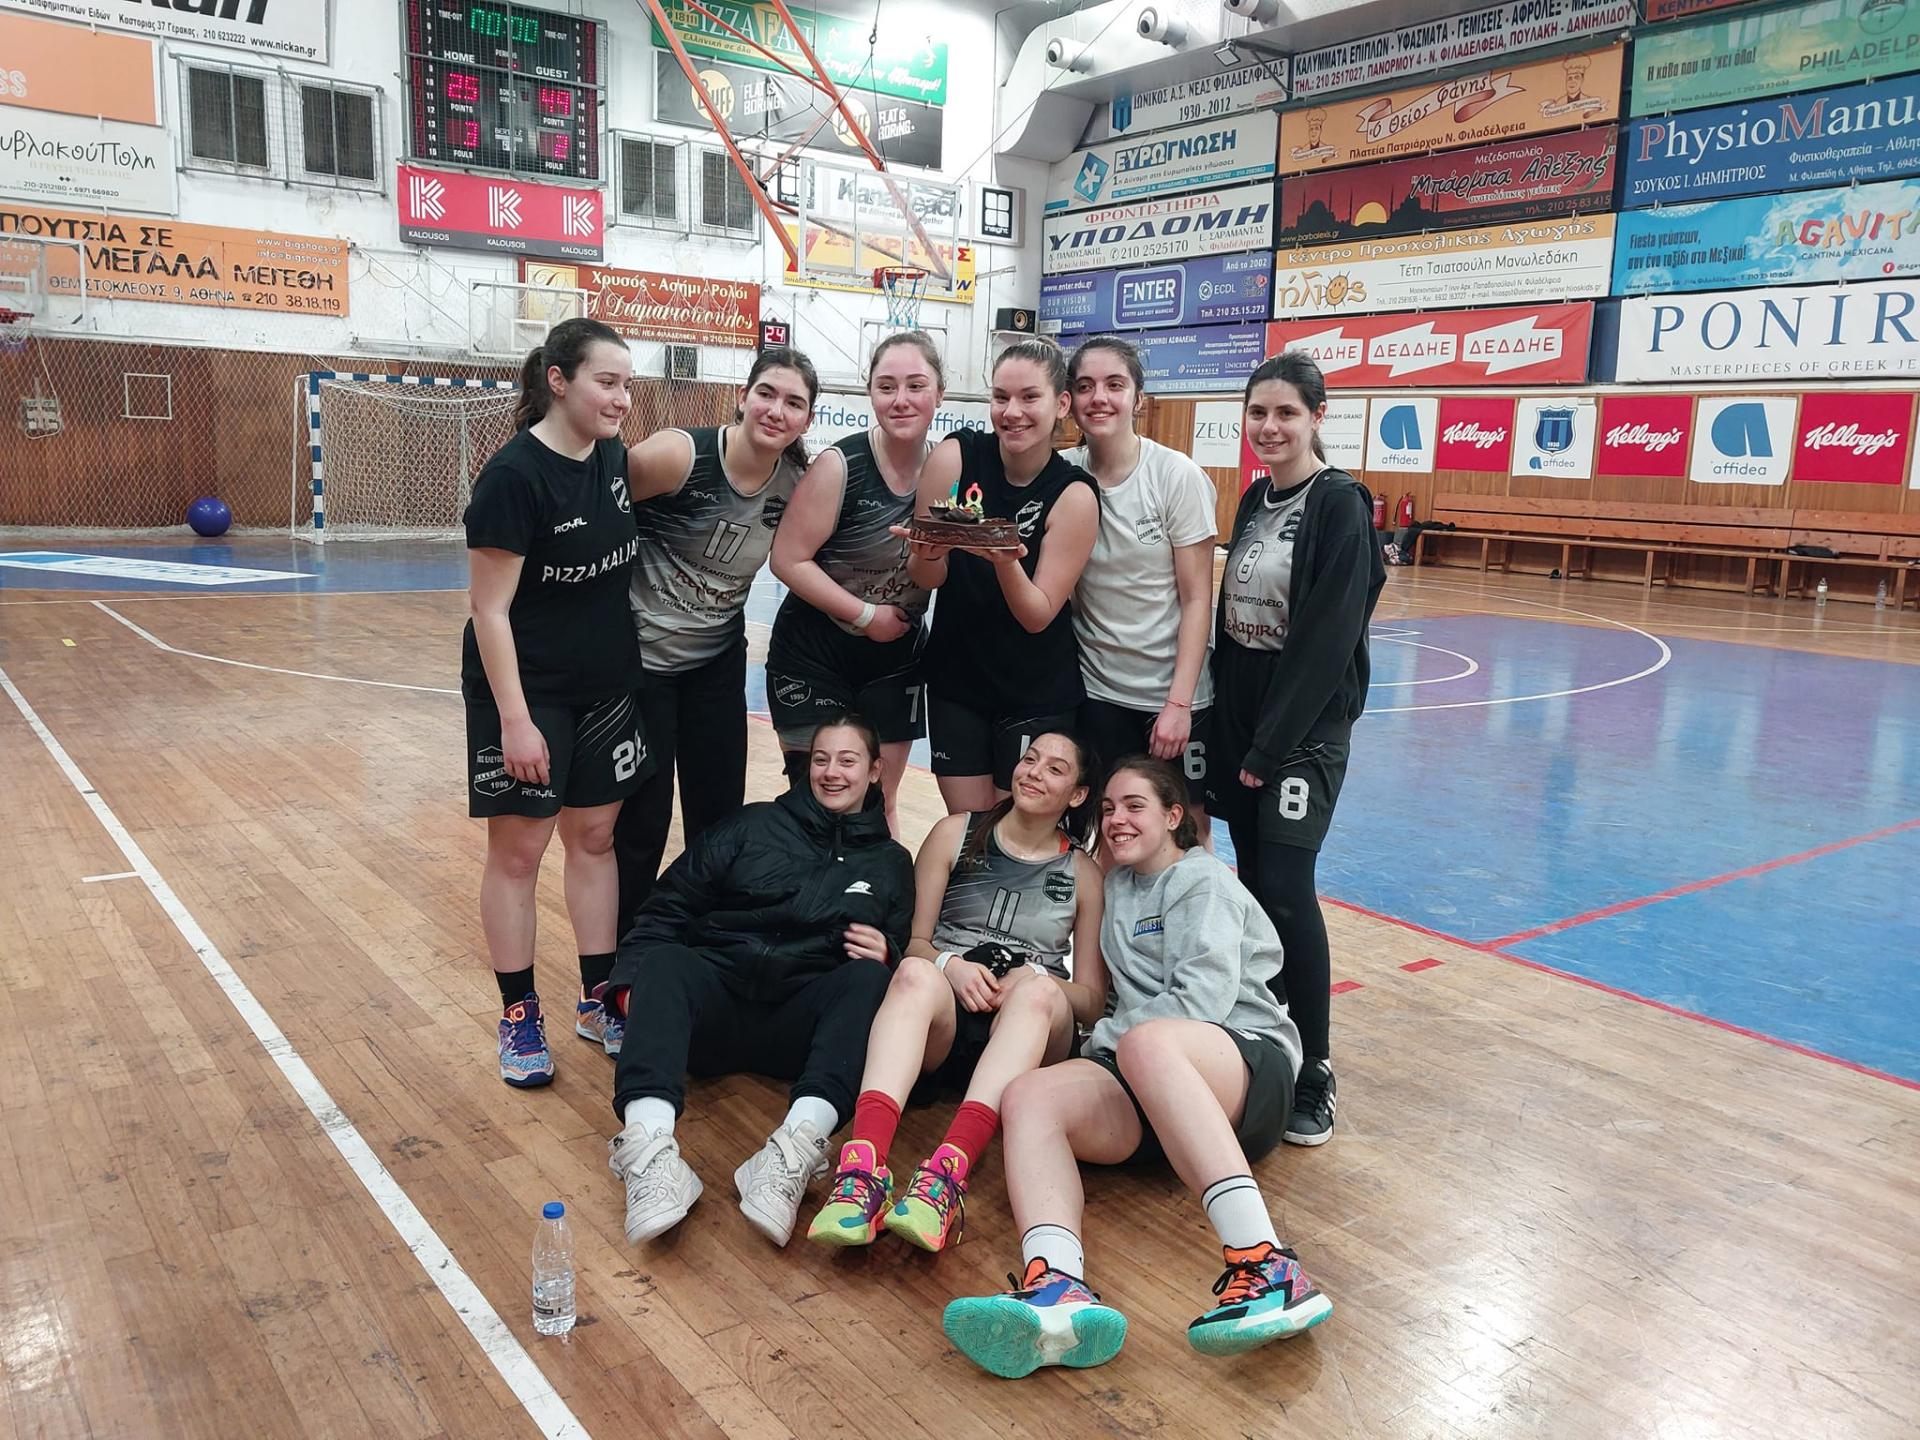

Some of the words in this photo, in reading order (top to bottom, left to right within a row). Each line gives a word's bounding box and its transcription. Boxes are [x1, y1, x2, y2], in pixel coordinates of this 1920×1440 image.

[203, 29, 216, 40] 210
[217, 31, 246, 44] 6232222
[250, 37, 316, 58] www.nickan.gr
[1295, 48, 1348, 77] ΚΑΛΥΜΜΑΤΑ
[1350, 38, 1390, 64] ΕΠΙΠΛΩΝ
[1397, 22, 1448, 50] ΥΦΑΣΜΑΤΑ
[1457, 10, 1503, 38] ΓΕΜΙΣΕΙΣ
[1295, 79, 1315, 93] ΤΗΛ.:
[1316, 73, 1329, 89] 210
[1331, 66, 1365, 87] 2517027,
[1367, 55, 1415, 78] ΠΑΝΟΡΜΟΥ
[1440, 36, 1507, 61] ΦΙΛΑΔΕΛΦΕΙΑ,
[1509, 23, 1558, 45] ΠΟΥΛΑΚΗ
[1567, 4, 1632, 33] ΔΑΝΙΗΛΙΔΟΥ
[443, 50, 475, 63] HOME
[535, 66, 569, 79] GUEST
[1647, 65, 1654, 81] Η
[1701, 57, 1711, 72] το
[449, 72, 480, 103] 25
[744, 81, 766, 100] FLAT
[1133, 88, 1168, 110] ΙΩΝΙΚΟΣ
[1170, 85, 1186, 102] Α.Σ.
[1188, 79, 1211, 97] ΝΕΑΣ
[1213, 61, 1285, 91] ΦΙΛΑΔΕΛΦΕΙΑΣ
[450, 103, 473, 113] POINTS
[879, 110, 899, 126] FLAT
[1179, 104, 1200, 121] 1930
[1208, 96, 1231, 115] 2012
[543, 117, 565, 127] POINTS
[1636, 94, 1920, 166] PhysioManu
[1349, 146, 1385, 160] Πλατεία
[1386, 136, 1443, 154] Πατριάρχου
[1445, 133, 1456, 144] Ν.
[1458, 121, 1526, 140] Φιλαδέλφεια
[453, 149, 474, 159] FOULS
[1115, 129, 1237, 173] ΕΥΡΩΓΝΩΣΗ
[1475, 146, 1543, 164] Μεζεδοπωλείο
[1790, 142, 1873, 164] Φυσικοθεραπεία
[545, 161, 564, 170] FOULS
[1634, 175, 1681, 194] ΣΟΥΚΟΣ
[1692, 164, 1767, 187] ΔΗΜΗΤΡΙΟΣ
[1789, 173, 1798, 182] Μ.
[1085, 194, 1221, 225] ΦΡΟΝΤΙΣΤΗΡΙΑ
[1548, 201, 1564, 213] 210
[1566, 199, 1577, 209] 25
[1579, 198, 1591, 208] 83
[139, 226, 174, 248] ΣΕ
[408, 230, 450, 241] KALOUSOS
[1049, 203, 1270, 251] ΥΠΟΔΟΜΗ
[1501, 219, 1595, 245] Αγωγής
[487, 238, 526, 249] KALOUSOS
[561, 246, 598, 256] KALOUSOS
[1120, 247, 1139, 260] 210
[1142, 240, 1189, 257] 2525170
[1630, 233, 1656, 249] Fiesta
[1249, 258, 1268, 268] 2002
[1400, 261, 1424, 278] Τέτη
[1427, 253, 1492, 276] Τσιατσούλη
[1496, 248, 1578, 268] Μανωλεδάκη
[1691, 250, 1707, 265] στο
[1801, 250, 1841, 260] CANTINA
[1843, 247, 1894, 257] MEXICANA
[84, 245, 219, 281] ΜΕΓΑΛΑ
[233, 264, 334, 291] ΜΕΓΕΘΗ
[50, 276, 167, 297] ΘΕΜΣΤΟΚΛΕΟΥΣ
[189, 287, 236, 302] ΑΘΗΝΑ
[256, 292, 278, 306] 210
[285, 294, 341, 311] 38.18.119
[592, 271, 647, 292] Χρυσός
[659, 277, 701, 298] Ασήμι
[711, 286, 748, 301] Ρολόι
[1122, 278, 1176, 303] ENTER
[1214, 285, 1236, 296] ECDL
[1216, 308, 1230, 317] 210
[1231, 304, 1265, 317] 25.15.273
[765, 325, 786, 345] 24
[1469, 336, 1556, 354] ΔΕΔΔΗΕ
[1373, 341, 1452, 358] ΔΕΔΔΗΕ
[1670, 362, 1791, 376] MASTERPIECES
[1800, 361, 1820, 373] OF
[1828, 359, 1888, 372] GREEK
[1195, 422, 1241, 439] ZEUS
[1442, 421, 1508, 449] Kellogg's
[1605, 422, 1684, 452] Kellogg's
[1804, 422, 1900, 456] Kellogg's
[1382, 453, 1419, 466] affidea
[1543, 458, 1575, 468] affidea
[1713, 462, 1768, 476] affidea
[703, 519, 751, 564] 17
[1236, 540, 1264, 584] 8
[542, 562, 597, 583] PIZZA
[906, 686, 920, 723] 7
[1184, 741, 1206, 780] 6
[490, 780, 509, 789] 1990
[521, 787, 557, 799] ROYAL
[1279, 777, 1310, 820] 8
[986, 887, 1021, 934] 11
